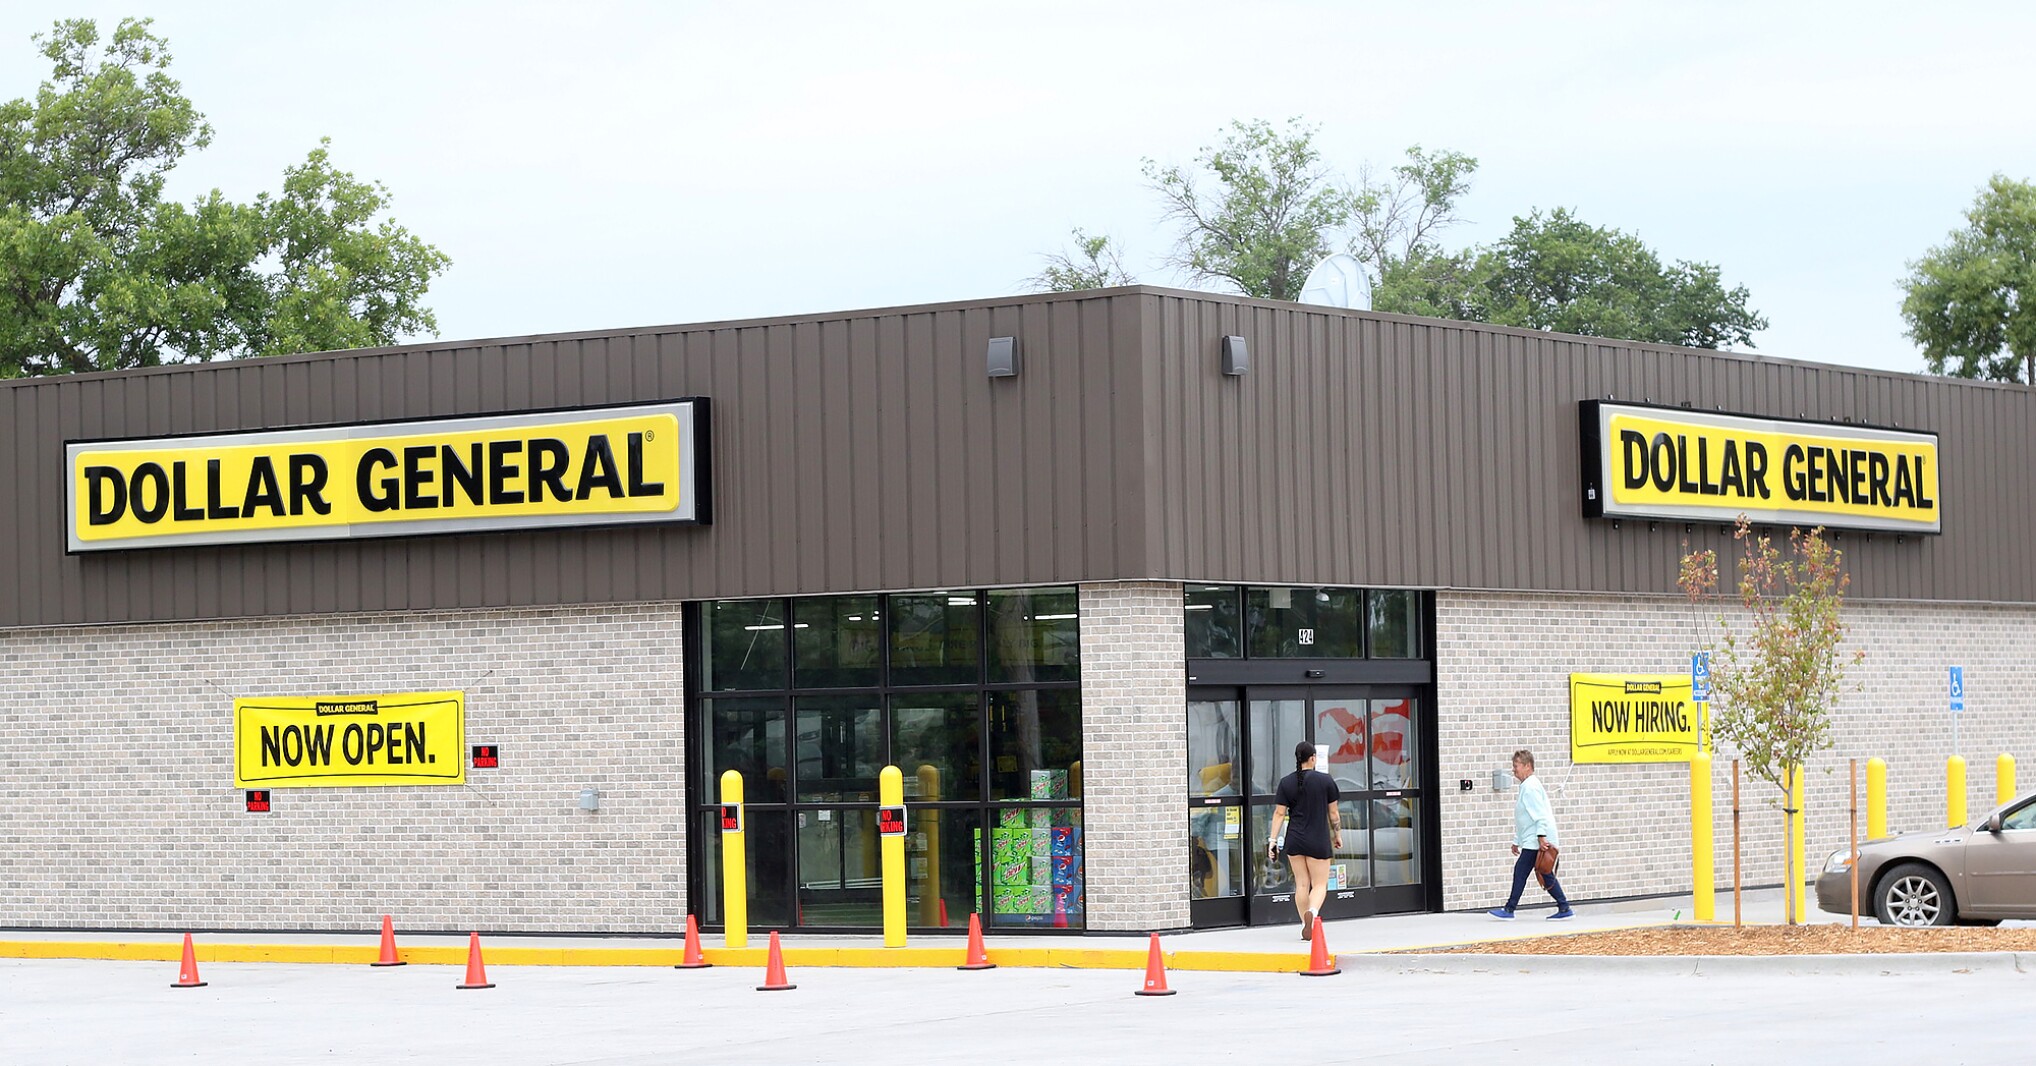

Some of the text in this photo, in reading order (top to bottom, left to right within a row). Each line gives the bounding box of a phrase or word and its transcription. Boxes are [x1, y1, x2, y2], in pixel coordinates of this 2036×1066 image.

[1620, 430, 1771, 500] DOLLAR
[84, 453, 332, 526] DOLLAR
[1300, 629, 1313, 644] 424
[1626, 683, 1643, 692] DOLLAR
[318, 704, 375, 713] DOLLAR GENERAL
[1592, 700, 1691, 733] NOW HIRING.
[261, 722, 436, 767] NOW OPEN.
[473, 757, 497, 768] PARKING
[881, 810, 892, 821] NO
